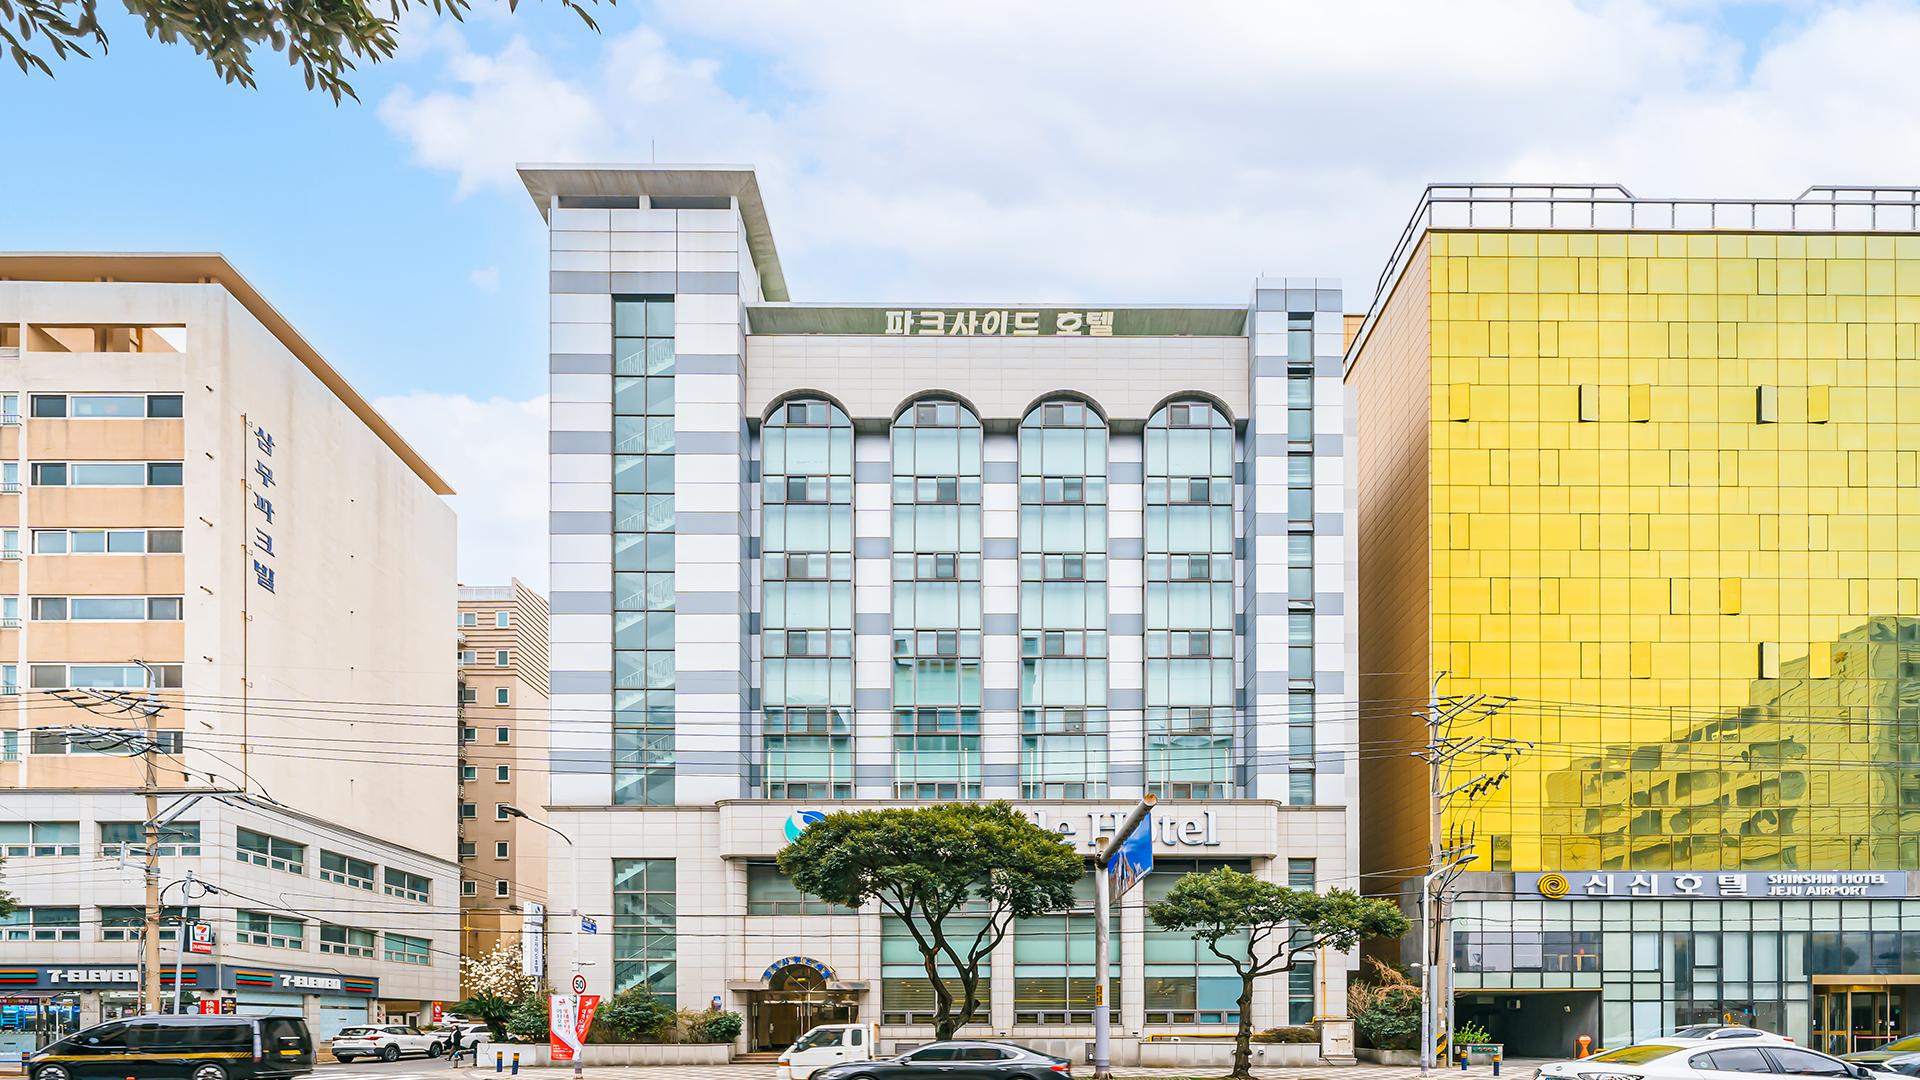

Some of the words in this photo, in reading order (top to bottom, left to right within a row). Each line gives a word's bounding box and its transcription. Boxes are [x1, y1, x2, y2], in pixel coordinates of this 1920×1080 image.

[885, 311, 1040, 336] 파크사이드
[1056, 311, 1114, 336] 호텔
[253, 427, 276, 594] 삼무파크빌
[1088, 810, 1221, 847] Htel
[1767, 874, 1838, 884] SHINSHIN
[1841, 874, 1888, 884] HOTEL
[1767, 886, 1802, 896] JEJU
[1805, 886, 1868, 896] AIRPORT
[575, 980, 584, 989] 50
